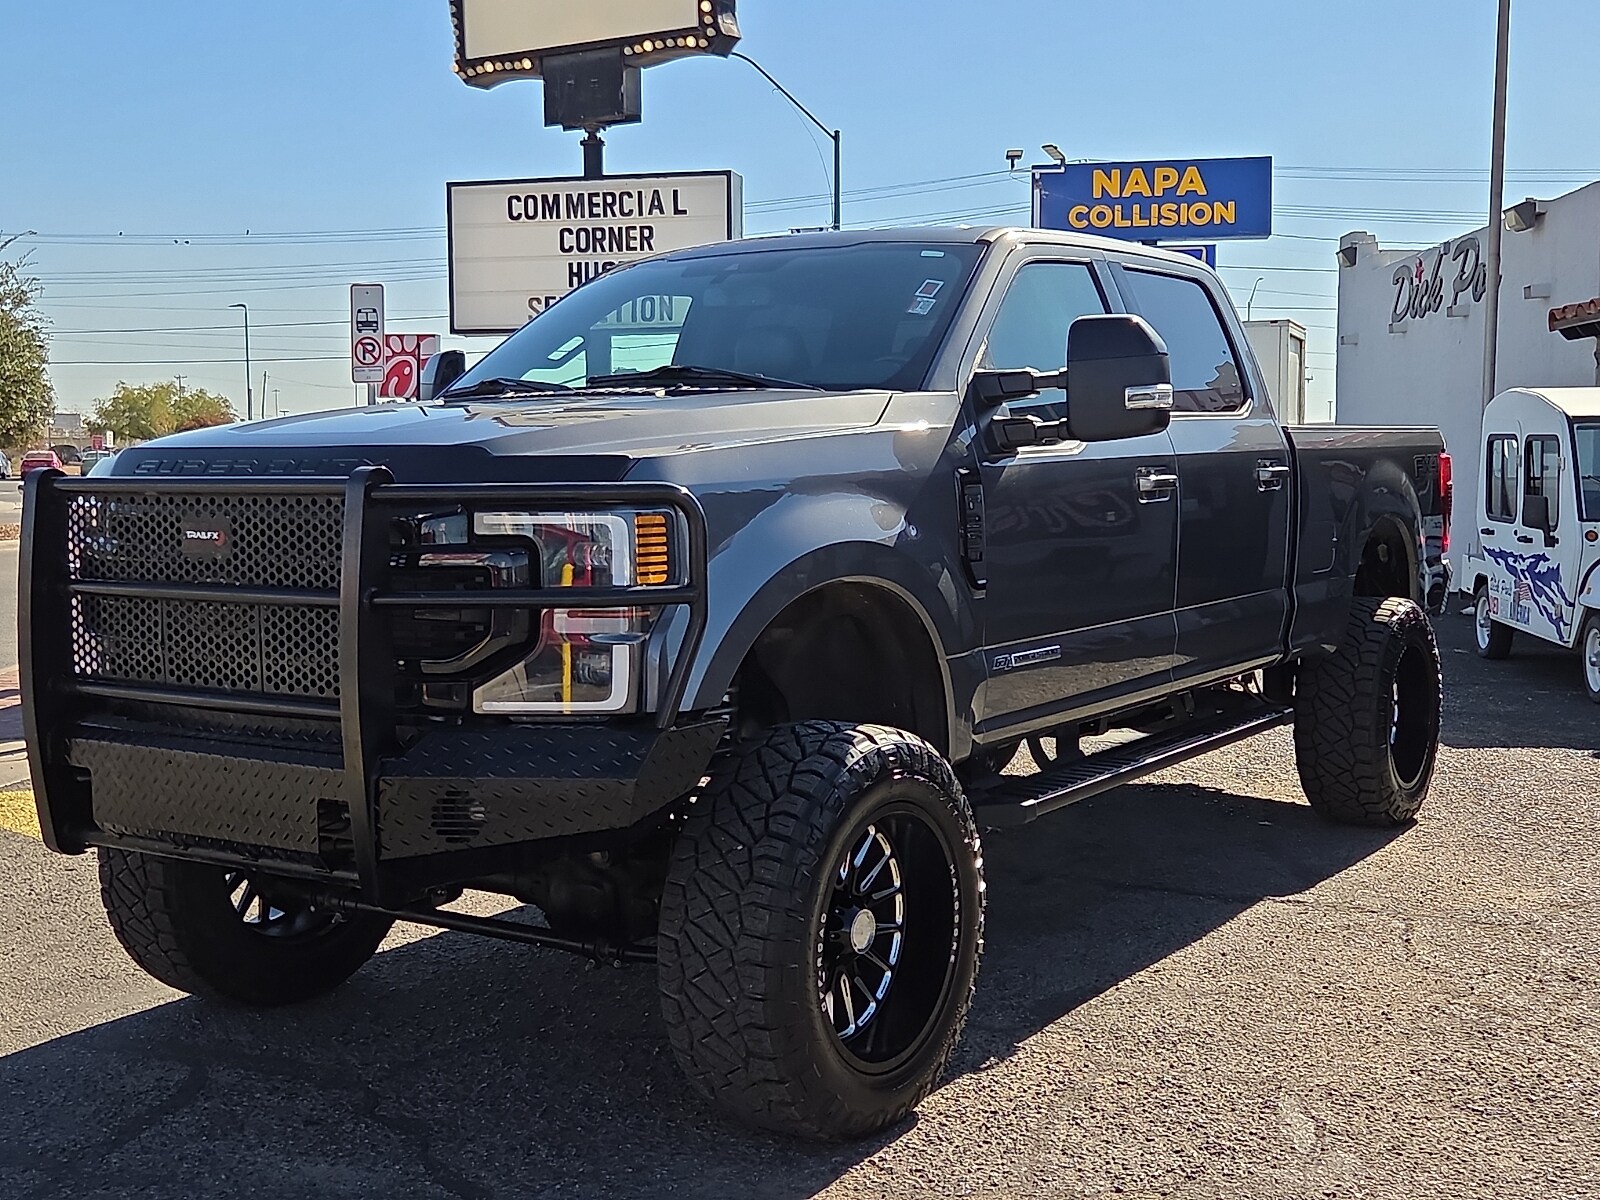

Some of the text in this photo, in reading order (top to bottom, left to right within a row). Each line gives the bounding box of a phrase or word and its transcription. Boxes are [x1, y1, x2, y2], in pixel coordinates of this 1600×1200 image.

[1091, 165, 1208, 199] NAPA
[507, 187, 688, 222] COMMERCIAL
[1067, 200, 1236, 230] COLLISION
[558, 224, 656, 254] CORNER
[1452, 236, 1502, 308] Po
[134, 458, 259, 474] SUPER
[185, 530, 219, 540] TRAILFX
